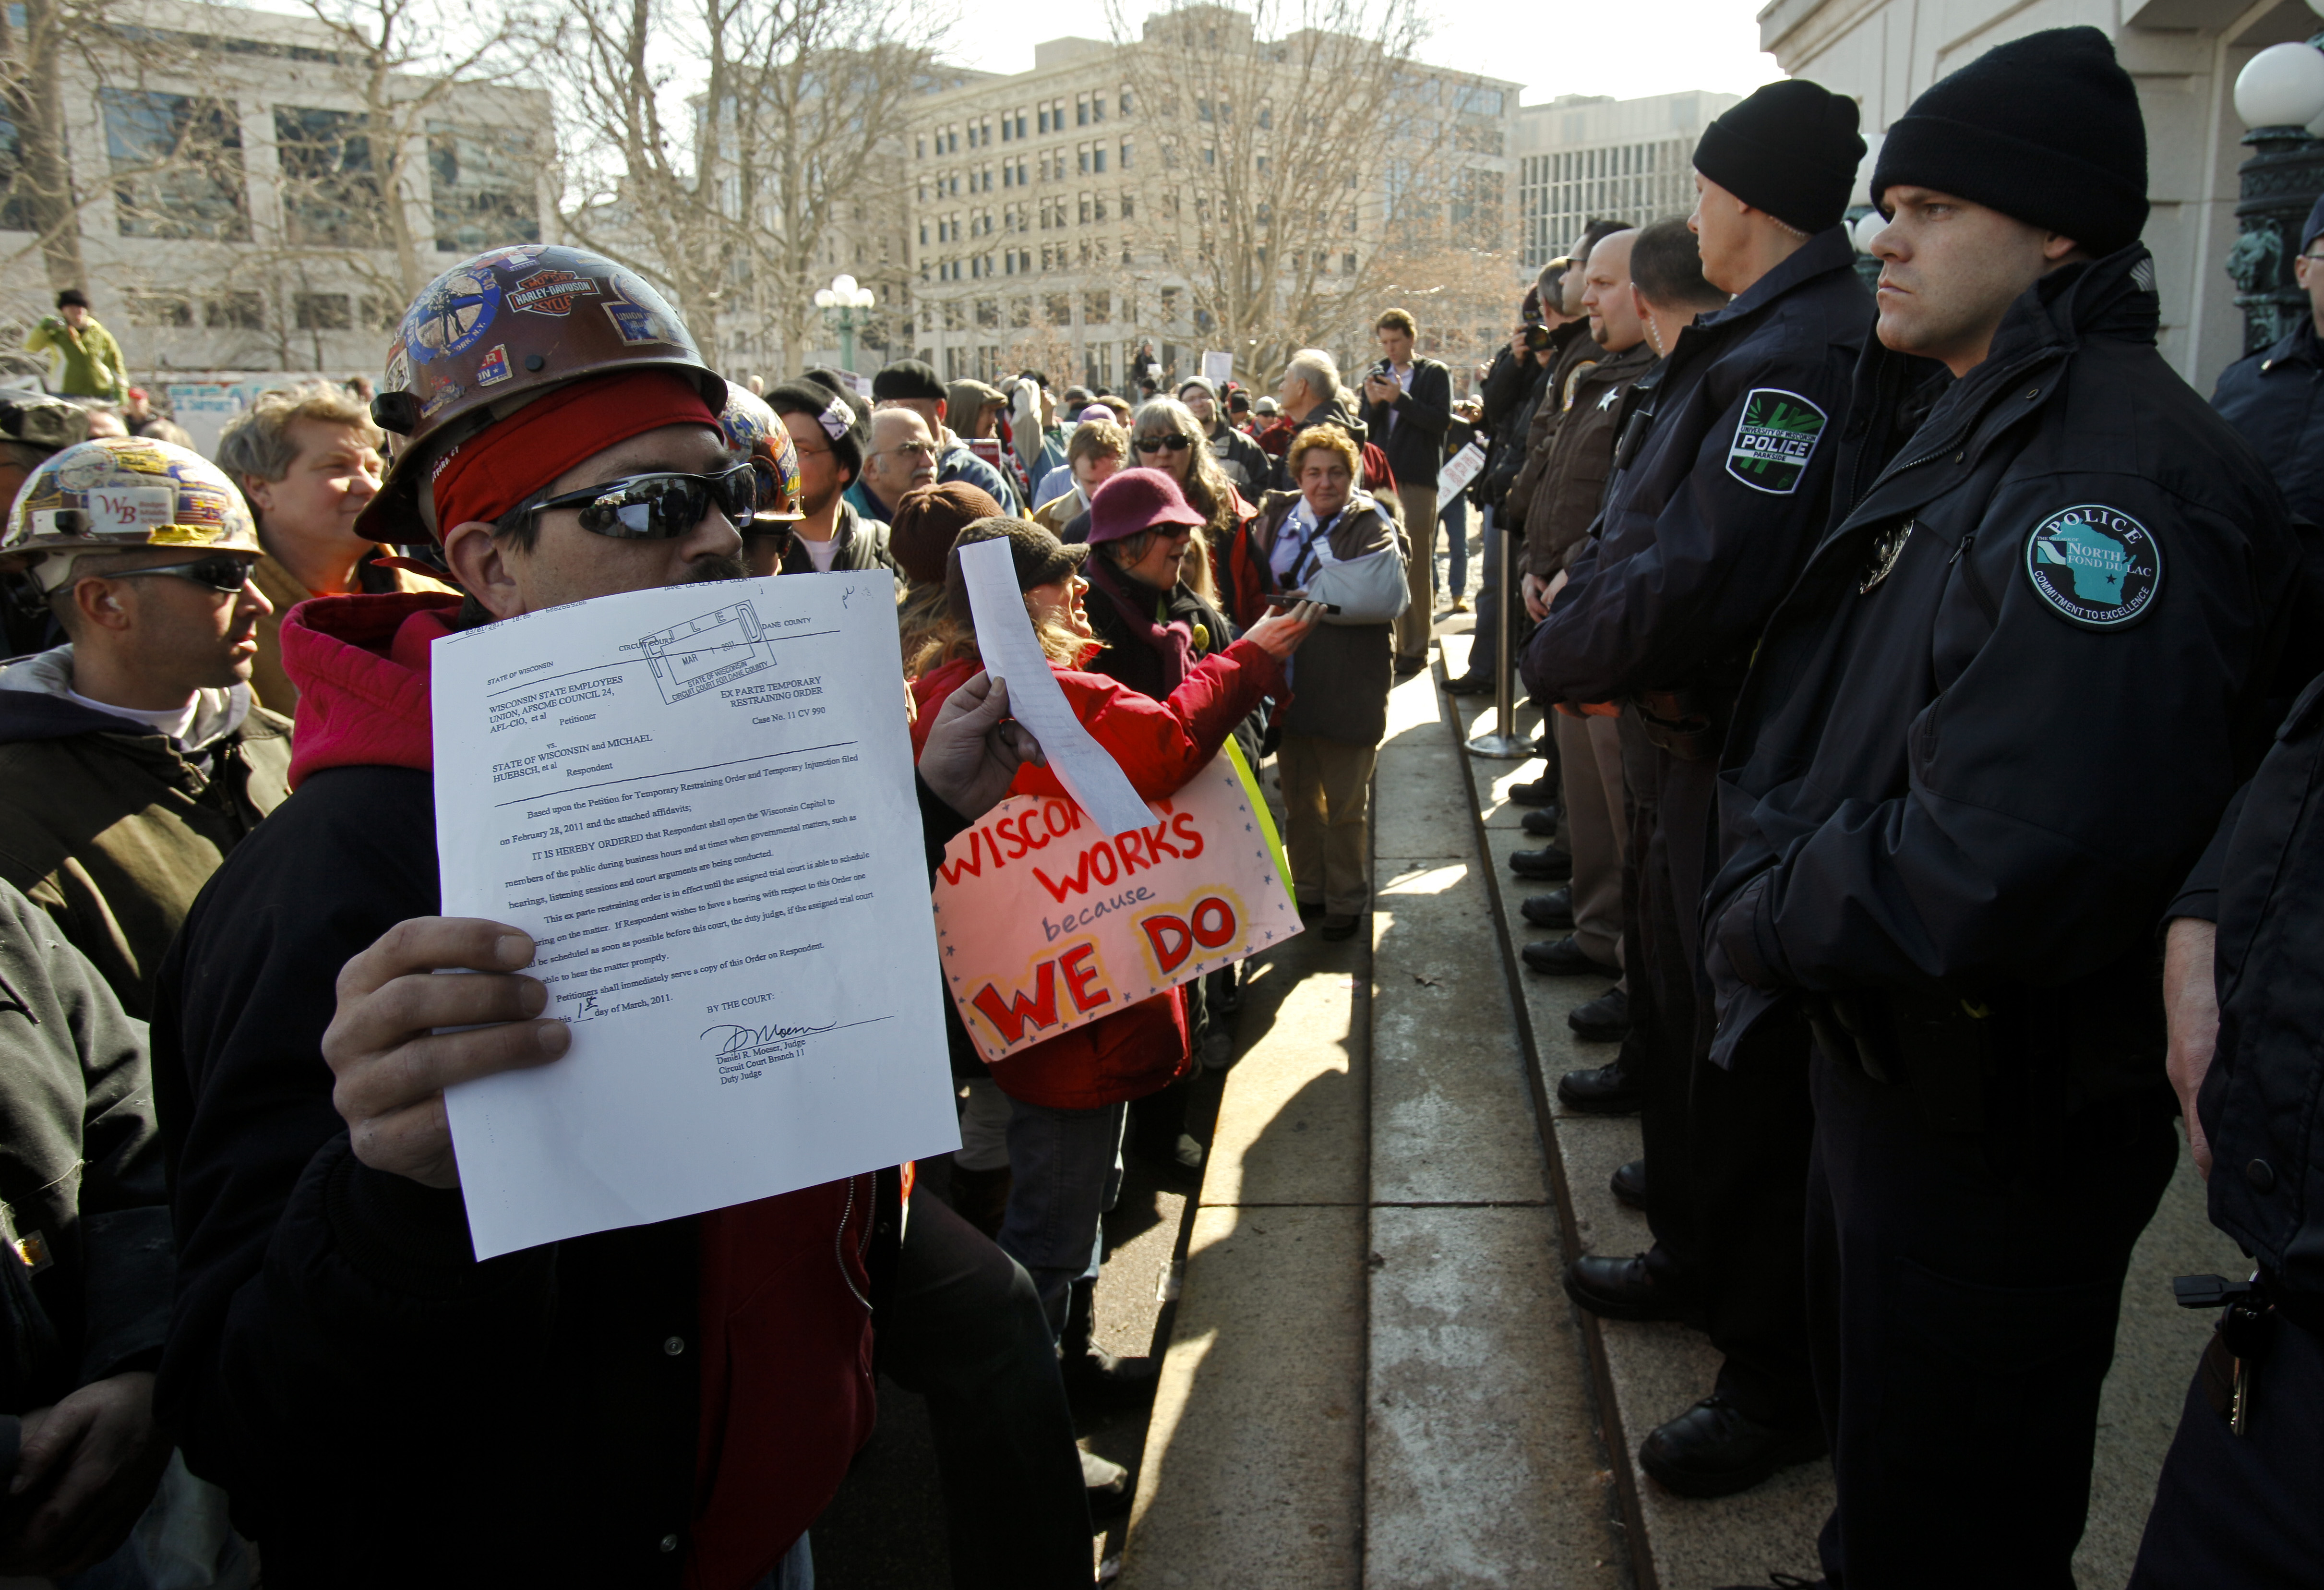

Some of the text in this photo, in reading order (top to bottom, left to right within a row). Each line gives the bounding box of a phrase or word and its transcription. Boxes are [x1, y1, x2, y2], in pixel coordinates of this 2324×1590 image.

[515, 282, 591, 305] HARLEY-DAVIDSON
[616, 312, 644, 321] UNION
[1740, 426, 1774, 436] UNIVERSITY
[1785, 432, 1816, 441] WISCONSIN
[1741, 434, 1809, 456] POLICE
[1753, 452, 1786, 461] PARKSIDE
[2046, 510, 2143, 544] POLICE
[2068, 542, 2121, 562] NORTH
[2069, 555, 2151, 577] FOND DU LAC
[2034, 570, 2150, 620] COMMITMENT TO EXCELLENCE
[762, 616, 812, 630] DANE COUNTY
[682, 653, 699, 666] MAR
[487, 674, 508, 686] STATE
[518, 661, 554, 675] WISCONSIN
[672, 661, 769, 701] CIRCUIT COURT FOR DANE COUNTY
[688, 661, 748, 687] STATE OF WISCONSIN
[489, 675, 623, 713] WISCONSIN STATE EMPLOYEES
[720, 676, 822, 699] EX PARTE TEMPORARY
[730, 687, 824, 708] RESTRAINING ORDER
[489, 687, 615, 723] UNION, AFSCME COUNCIL 24,
[752, 707, 826, 725] Case No. 11 CV 990
[490, 717, 528, 734] AFL-CIO,
[539, 711, 547, 720] al
[559, 713, 597, 726] Petitioner
[492, 734, 653, 773] STATE OF WISCONSIN and MICHAEL
[493, 765, 540, 783] HUEBSCH,
[550, 761, 558, 770] al
[565, 762, 614, 777] Respondent
[527, 754, 859, 819] Based upon the Petition for Temporary Restraining Order and Temporary Injunction filed
[512, 831, 548, 843] February
[549, 826, 563, 835] 28,
[563, 822, 584, 833] 2011
[586, 819, 602, 829] and
[602, 818, 616, 826] the
[617, 810, 651, 823] attached
[652, 805, 692, 817] affidavits;
[532, 852, 542, 861] IT
[543, 850, 554, 858] IS
[555, 842, 596, 856] HEREBY
[598, 834, 644, 849] ORDERED
[645, 831, 662, 840] that
[662, 822, 707, 837] Respondent
[708, 818, 726, 828] shall
[727, 816, 746, 825] open
[759, 804, 799, 817] Wisconsin
[800, 798, 827, 810] Capitol
[504, 875, 544, 888] members
[545, 871, 555, 880] of
[556, 870, 569, 878] the
[569, 864, 596, 878] public
[598, 860, 624, 870] during
[624, 854, 659, 865] business
[659, 849, 683, 858] hours
[684, 844, 698, 854] and
[707, 840, 728, 849] times
[729, 835, 749, 844] when
[750, 823, 801, 841] governmental
[802, 820, 831, 830] matters,
[831, 815, 848, 824] such
[1032, 812, 1204, 903] WORKS
[1042, 886, 1155, 941] because
[972, 897, 1235, 1046] WE DO
[594, 994, 673, 1017] day of March, 2011.
[706, 993, 775, 1013] BY THE COURT:
[716, 1039, 806, 1065] Daniel R. Moeser, Judge
[719, 1048, 804, 1074] Circuit Court Branch 11
[719, 1070, 763, 1085] Duty Judge
